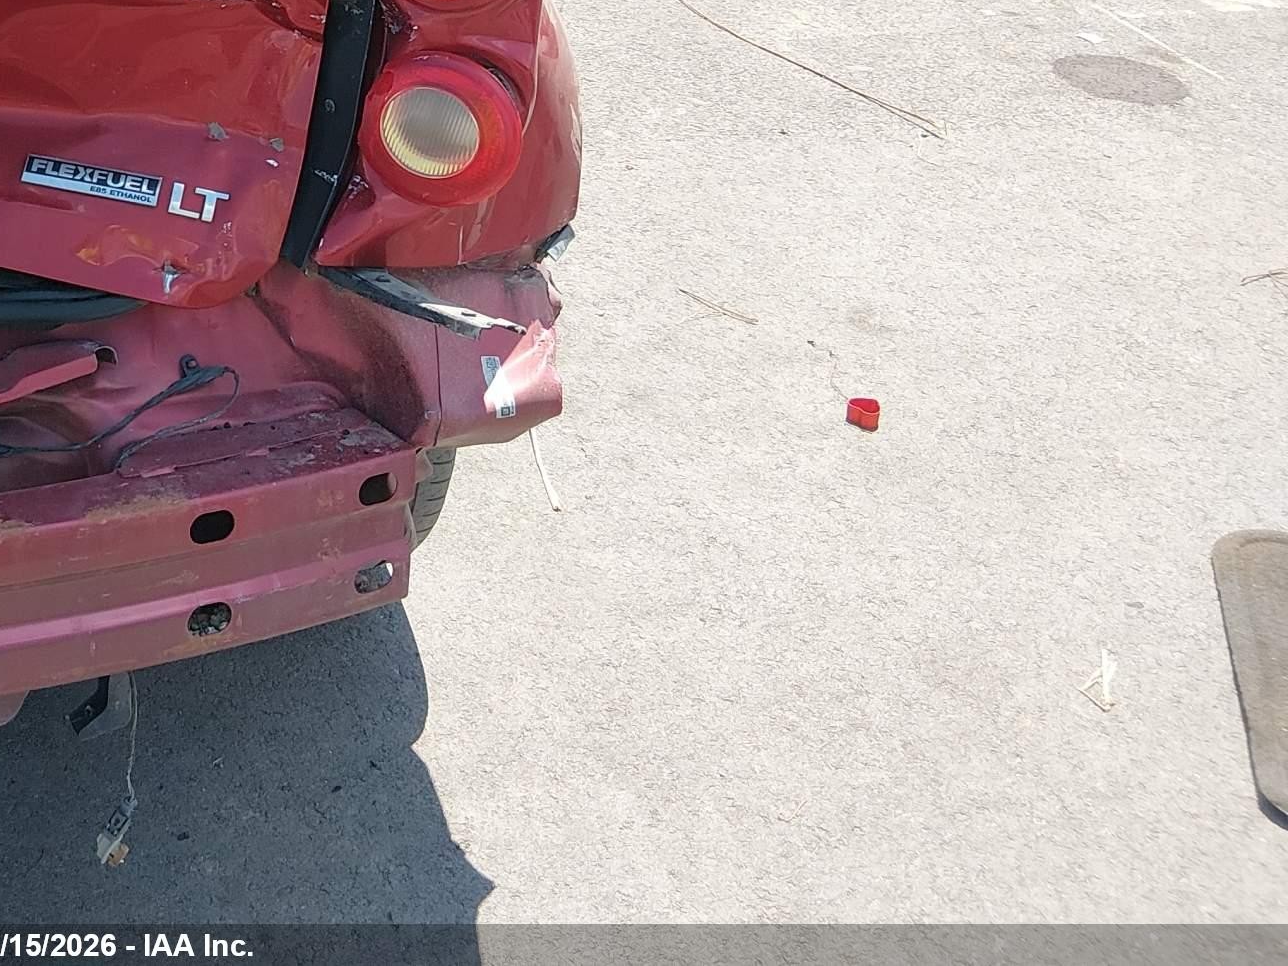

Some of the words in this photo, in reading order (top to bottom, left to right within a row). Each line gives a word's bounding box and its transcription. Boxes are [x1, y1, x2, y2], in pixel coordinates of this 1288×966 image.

[30, 158, 155, 195] FLEXFUEL
[89, 185, 107, 195] E85
[109, 187, 153, 204] ETHANOL
[168, 181, 230, 223] LT
